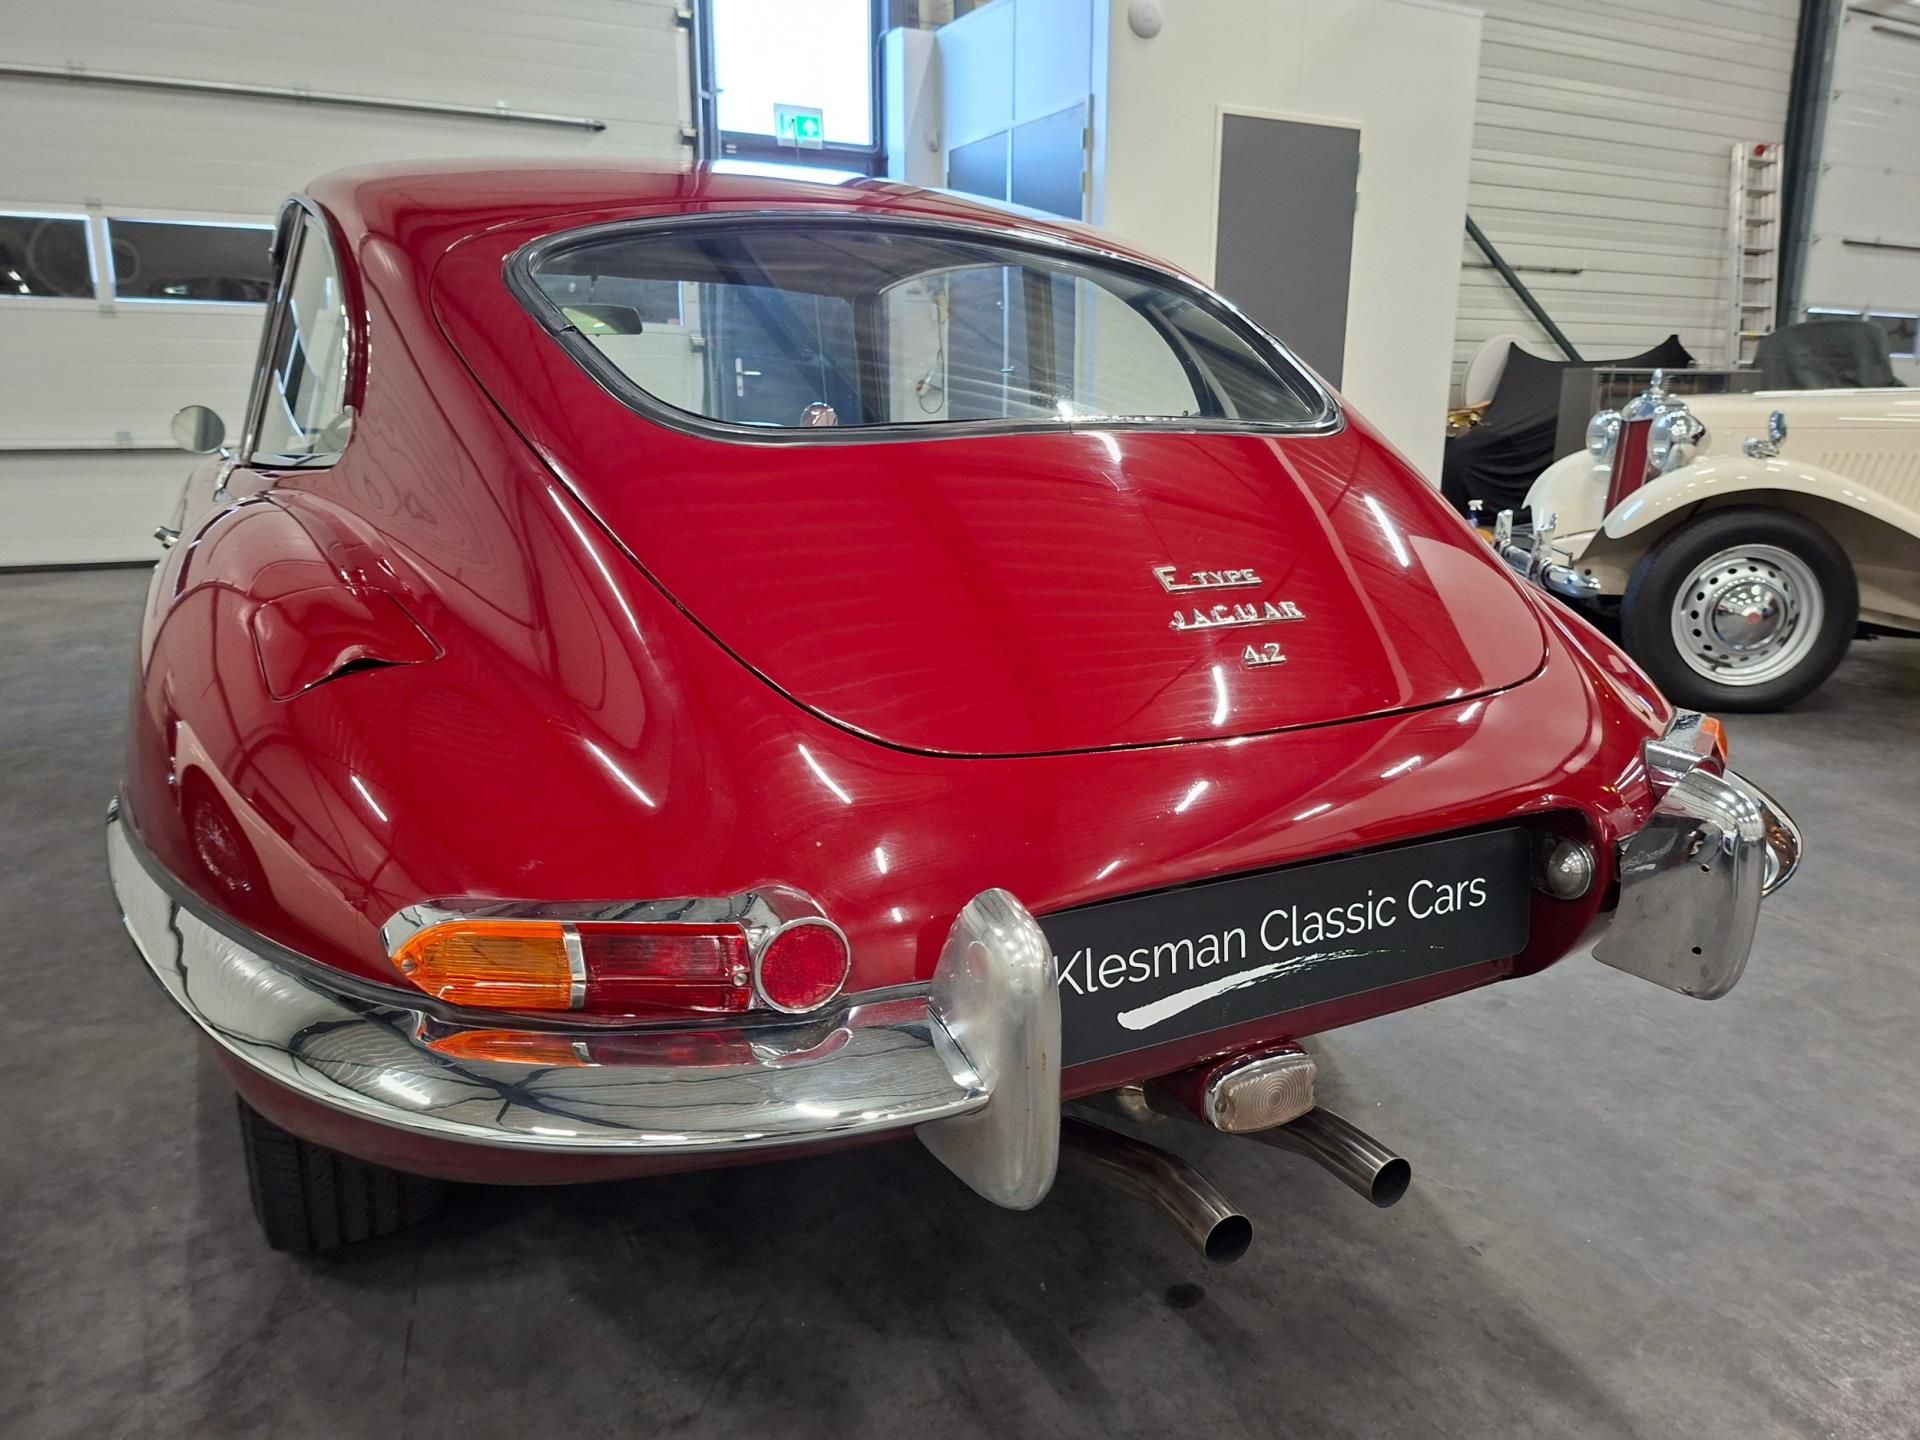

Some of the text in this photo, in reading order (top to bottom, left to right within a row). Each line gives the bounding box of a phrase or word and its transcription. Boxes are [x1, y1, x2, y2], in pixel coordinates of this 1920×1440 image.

[1153, 566, 1262, 592] E TYPE
[1169, 601, 1305, 629] JAGUAR
[1243, 643, 1286, 667] 4.2
[1053, 876, 1487, 995] Klesman Classic Cars
